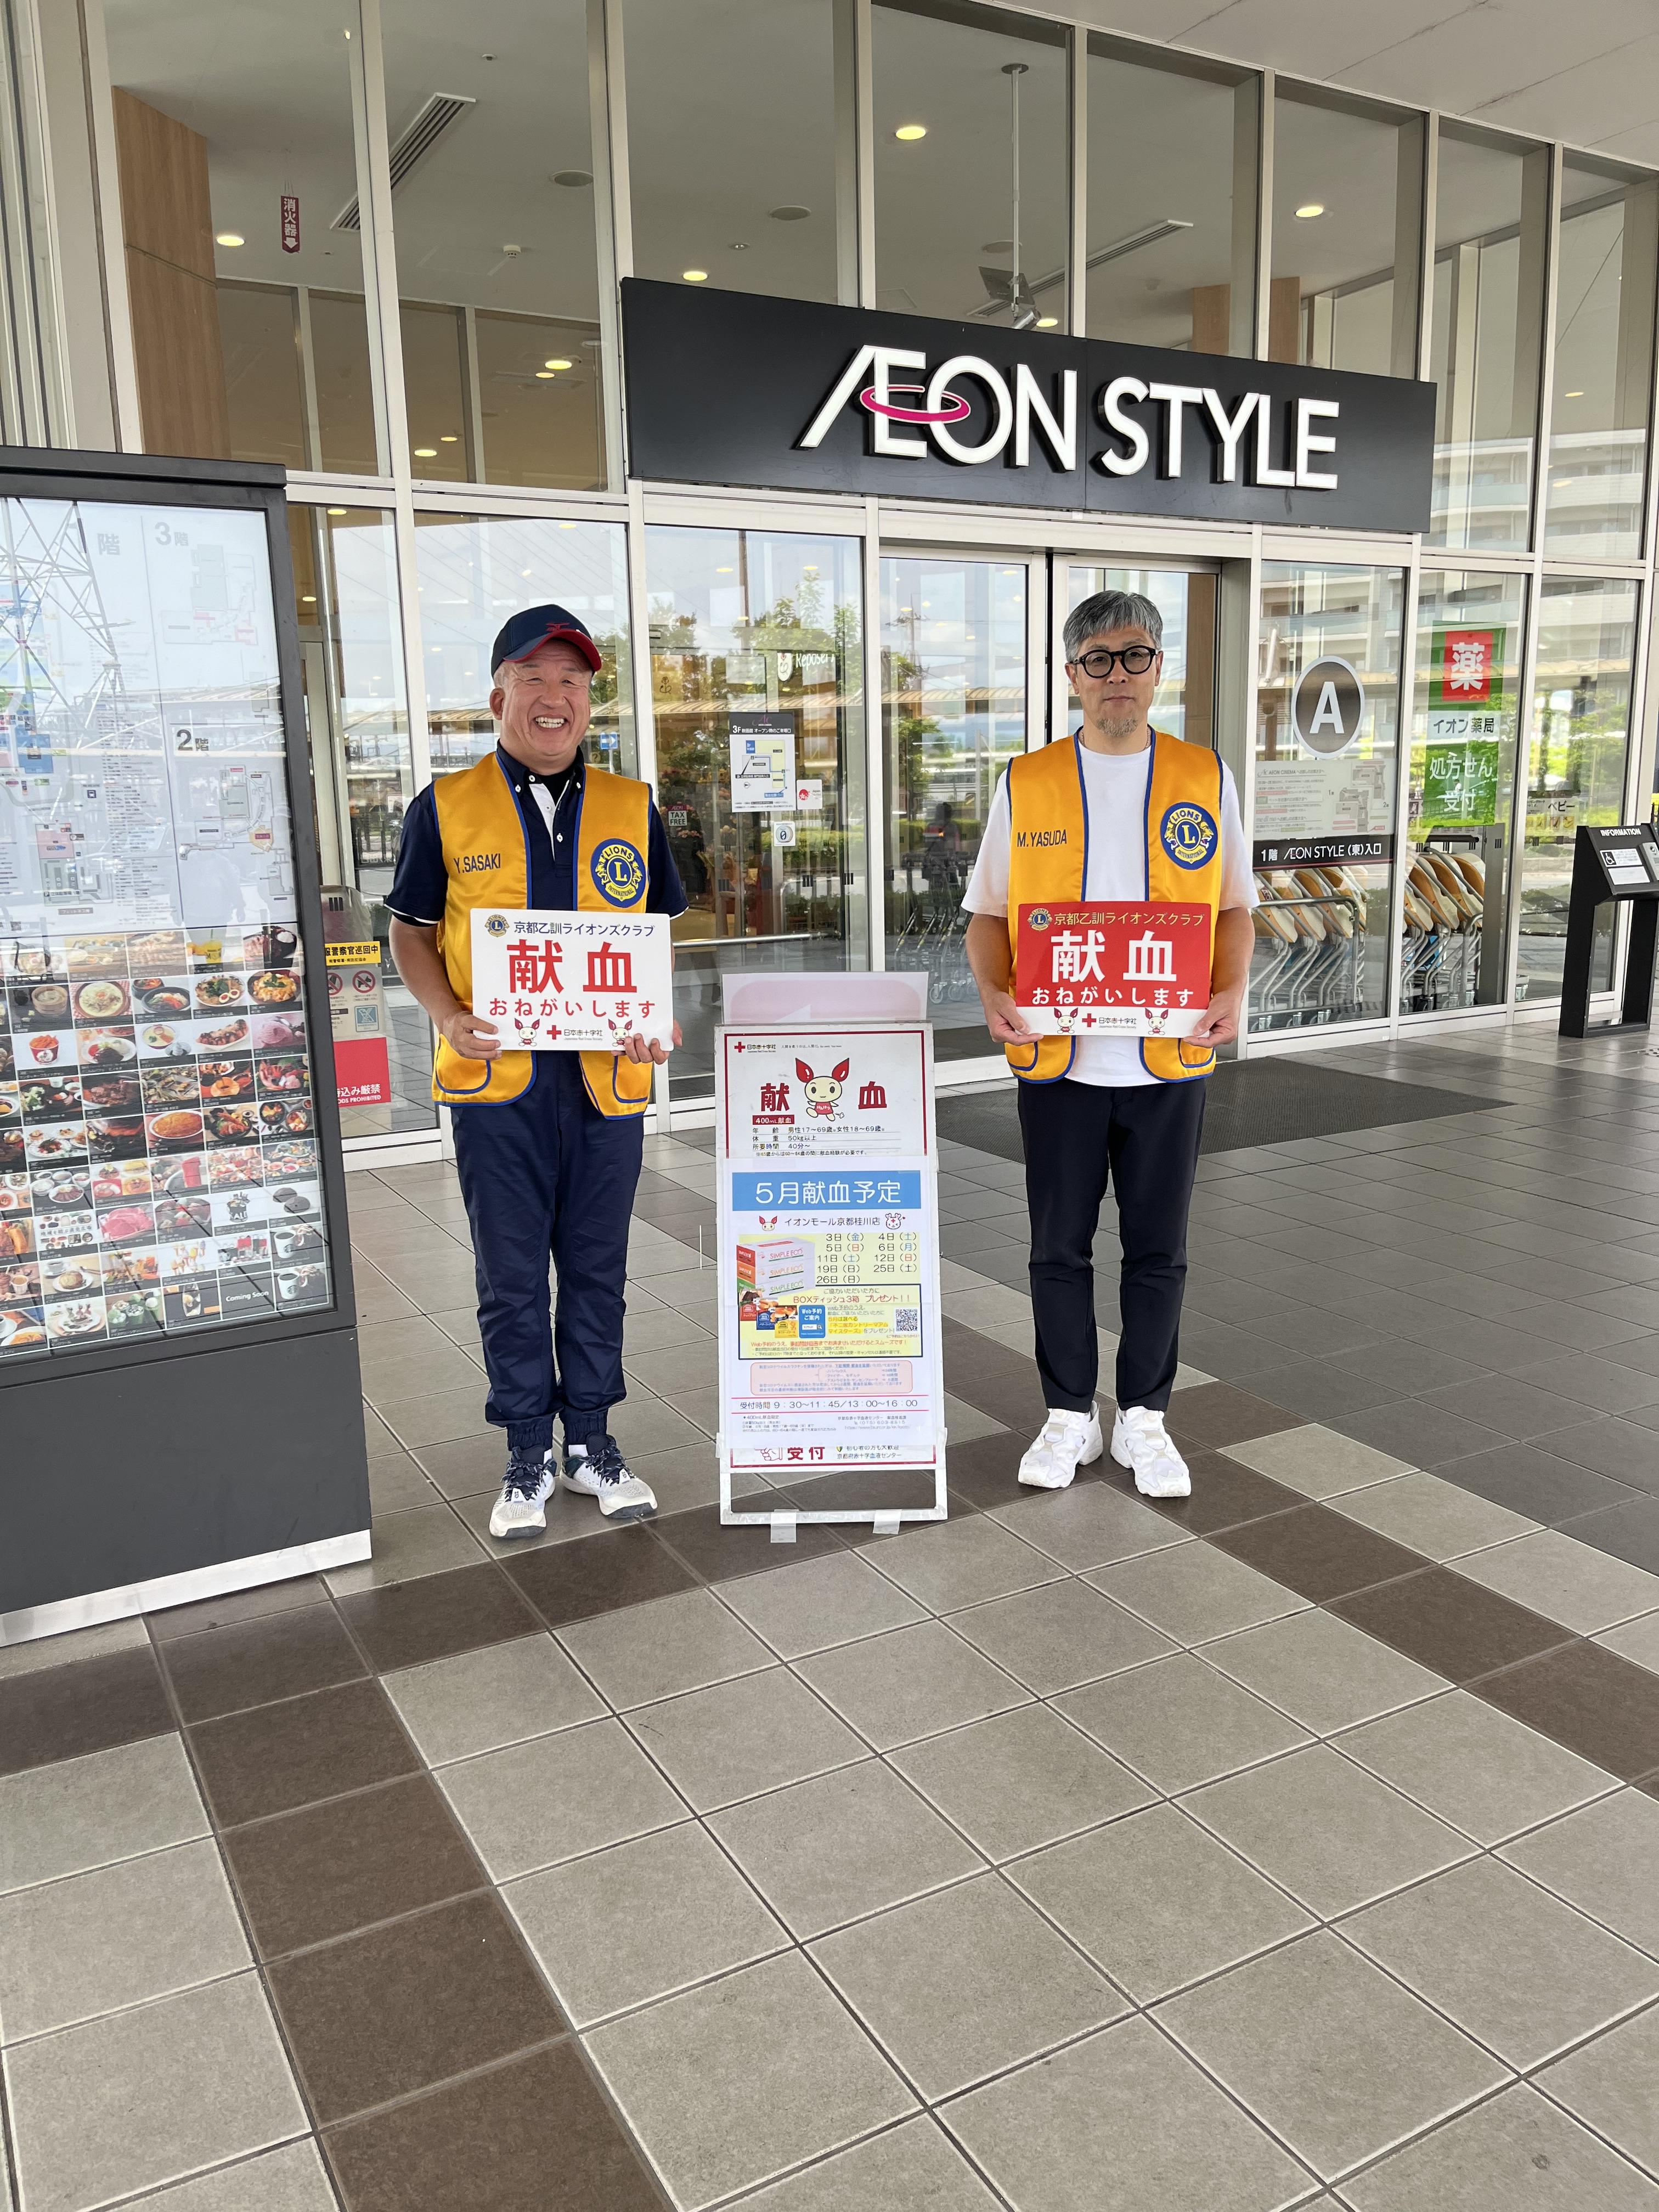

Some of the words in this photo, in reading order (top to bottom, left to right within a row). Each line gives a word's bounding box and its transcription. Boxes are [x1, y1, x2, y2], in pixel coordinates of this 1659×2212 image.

[284, 198, 297, 236] 消火器
[1100, 376, 1340, 490] STYLE
[155, 522, 189, 546] 3階
[1451, 643, 1484, 691] 薬
[1310, 681, 1345, 734] A
[732, 725, 741, 733] 3F
[1433, 717, 1494, 734] イオン薬局
[176, 729, 209, 752] 2階
[1430, 752, 1493, 780] 処方せん
[1444, 789, 1476, 811] 受付
[1171, 809, 1200, 822] LIONS
[1017, 830, 1067, 848] M.YASUDA
[1183, 825, 1195, 845] L
[1600, 828, 1641, 837] INFORMATION
[605, 845, 634, 860] LIONS
[1261, 849, 1278, 861] 1階
[1314, 845, 1344, 857] STYLE
[454, 853, 501, 874] Y.SASAKI
[614, 861, 627, 882] L
[1054, 912, 1205, 926] 京都乙訓ライオンズクラブ
[514, 921, 655, 937] 京都乙訓ライオンズクラブ
[1051, 930, 1177, 983] 献血
[506, 939, 637, 994] 献血
[1032, 986, 1194, 1007] おねがいします
[489, 998, 655, 1018] おねがいします
[350, 1095, 381, 1103] PROHIBITED
[755, 1180, 901, 1205] 5月献血予定
[785, 1216, 880, 1227] イオンモール京都桂川店
[770, 1251, 789, 1260] SIMPLE
[770, 1268, 789, 1276] SIMPLE
[770, 1284, 789, 1293] SIMPLE
[225, 1294, 251, 1302] Coming
[793, 1295, 859, 1304] BOXティッシュ3箱
[787, 1446, 825, 1460] 受付
